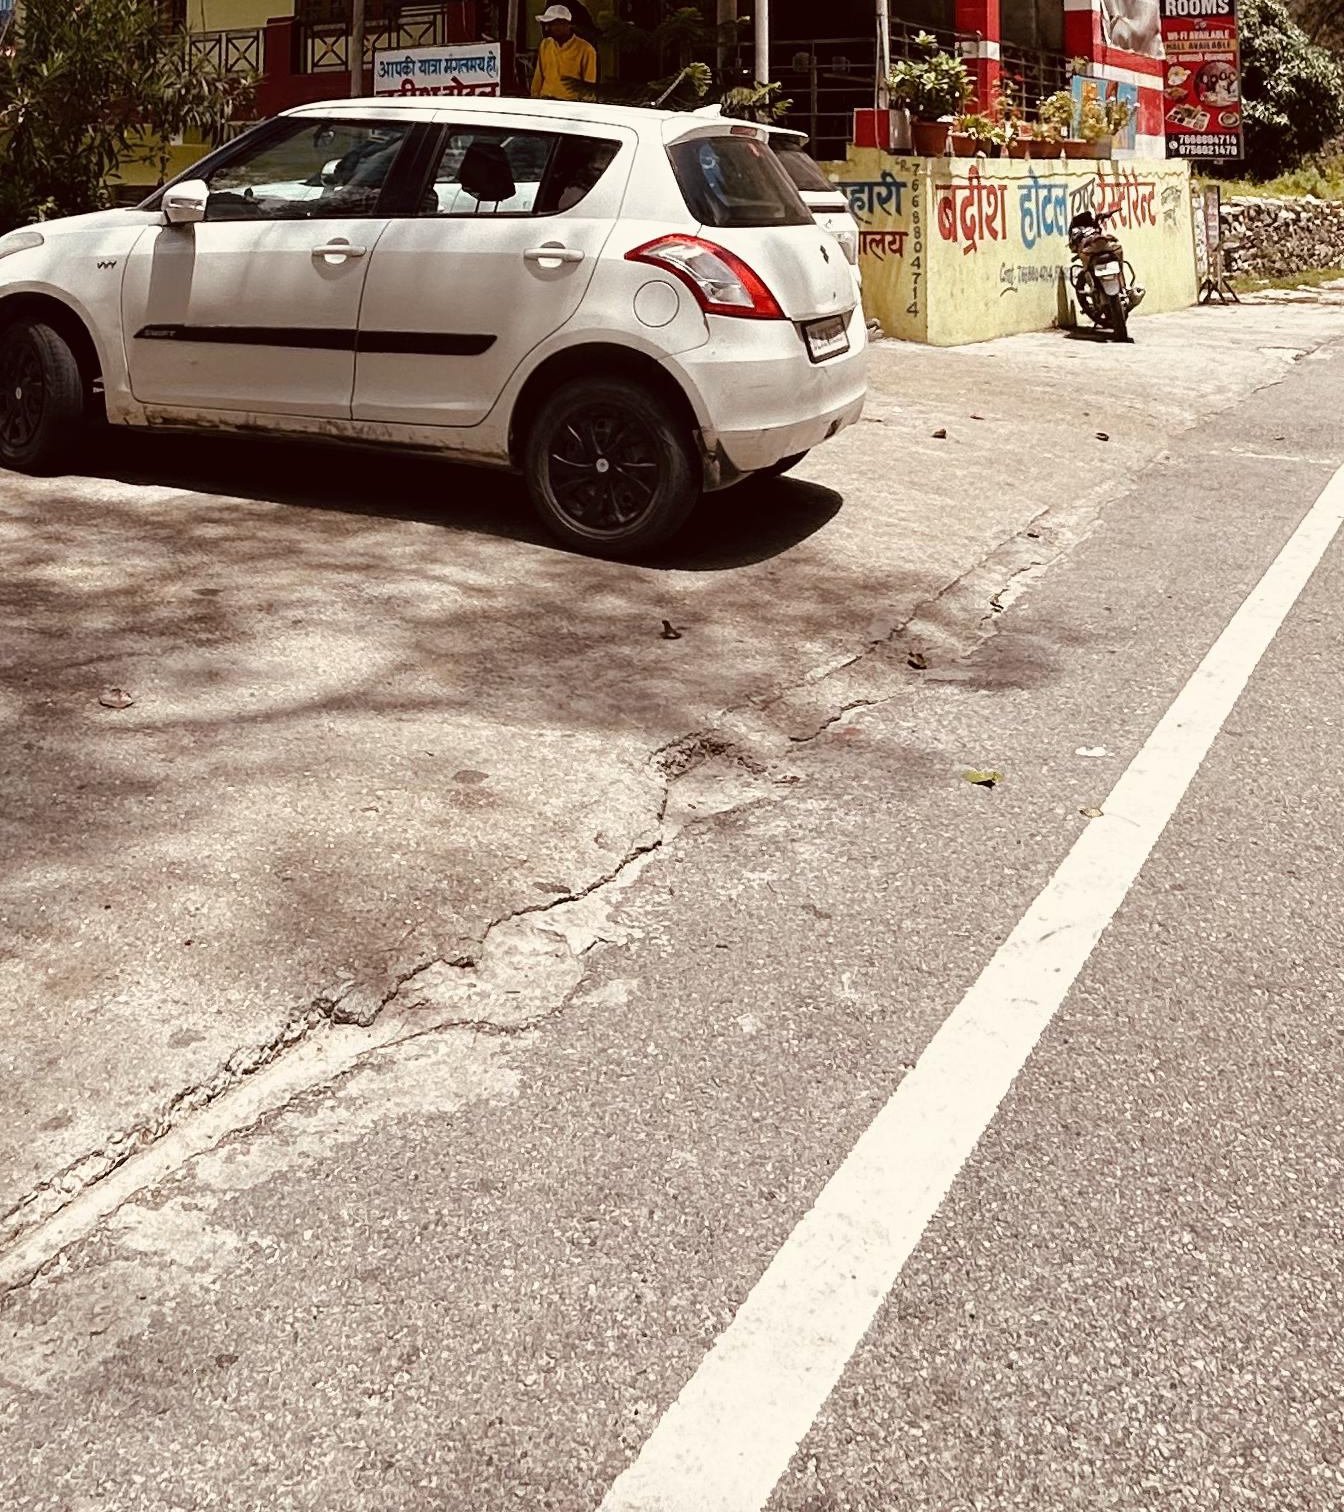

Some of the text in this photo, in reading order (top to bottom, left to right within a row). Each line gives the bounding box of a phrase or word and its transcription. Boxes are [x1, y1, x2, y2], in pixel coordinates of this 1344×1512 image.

[377, 55, 415, 78] आपकी
[417, 58, 442, 77] यात्रा
[443, 53, 485, 74] मंगलमय
[936, 164, 1008, 256] बद्रीश
[1017, 165, 1069, 250] होटल
[858, 231, 909, 261] ालय
